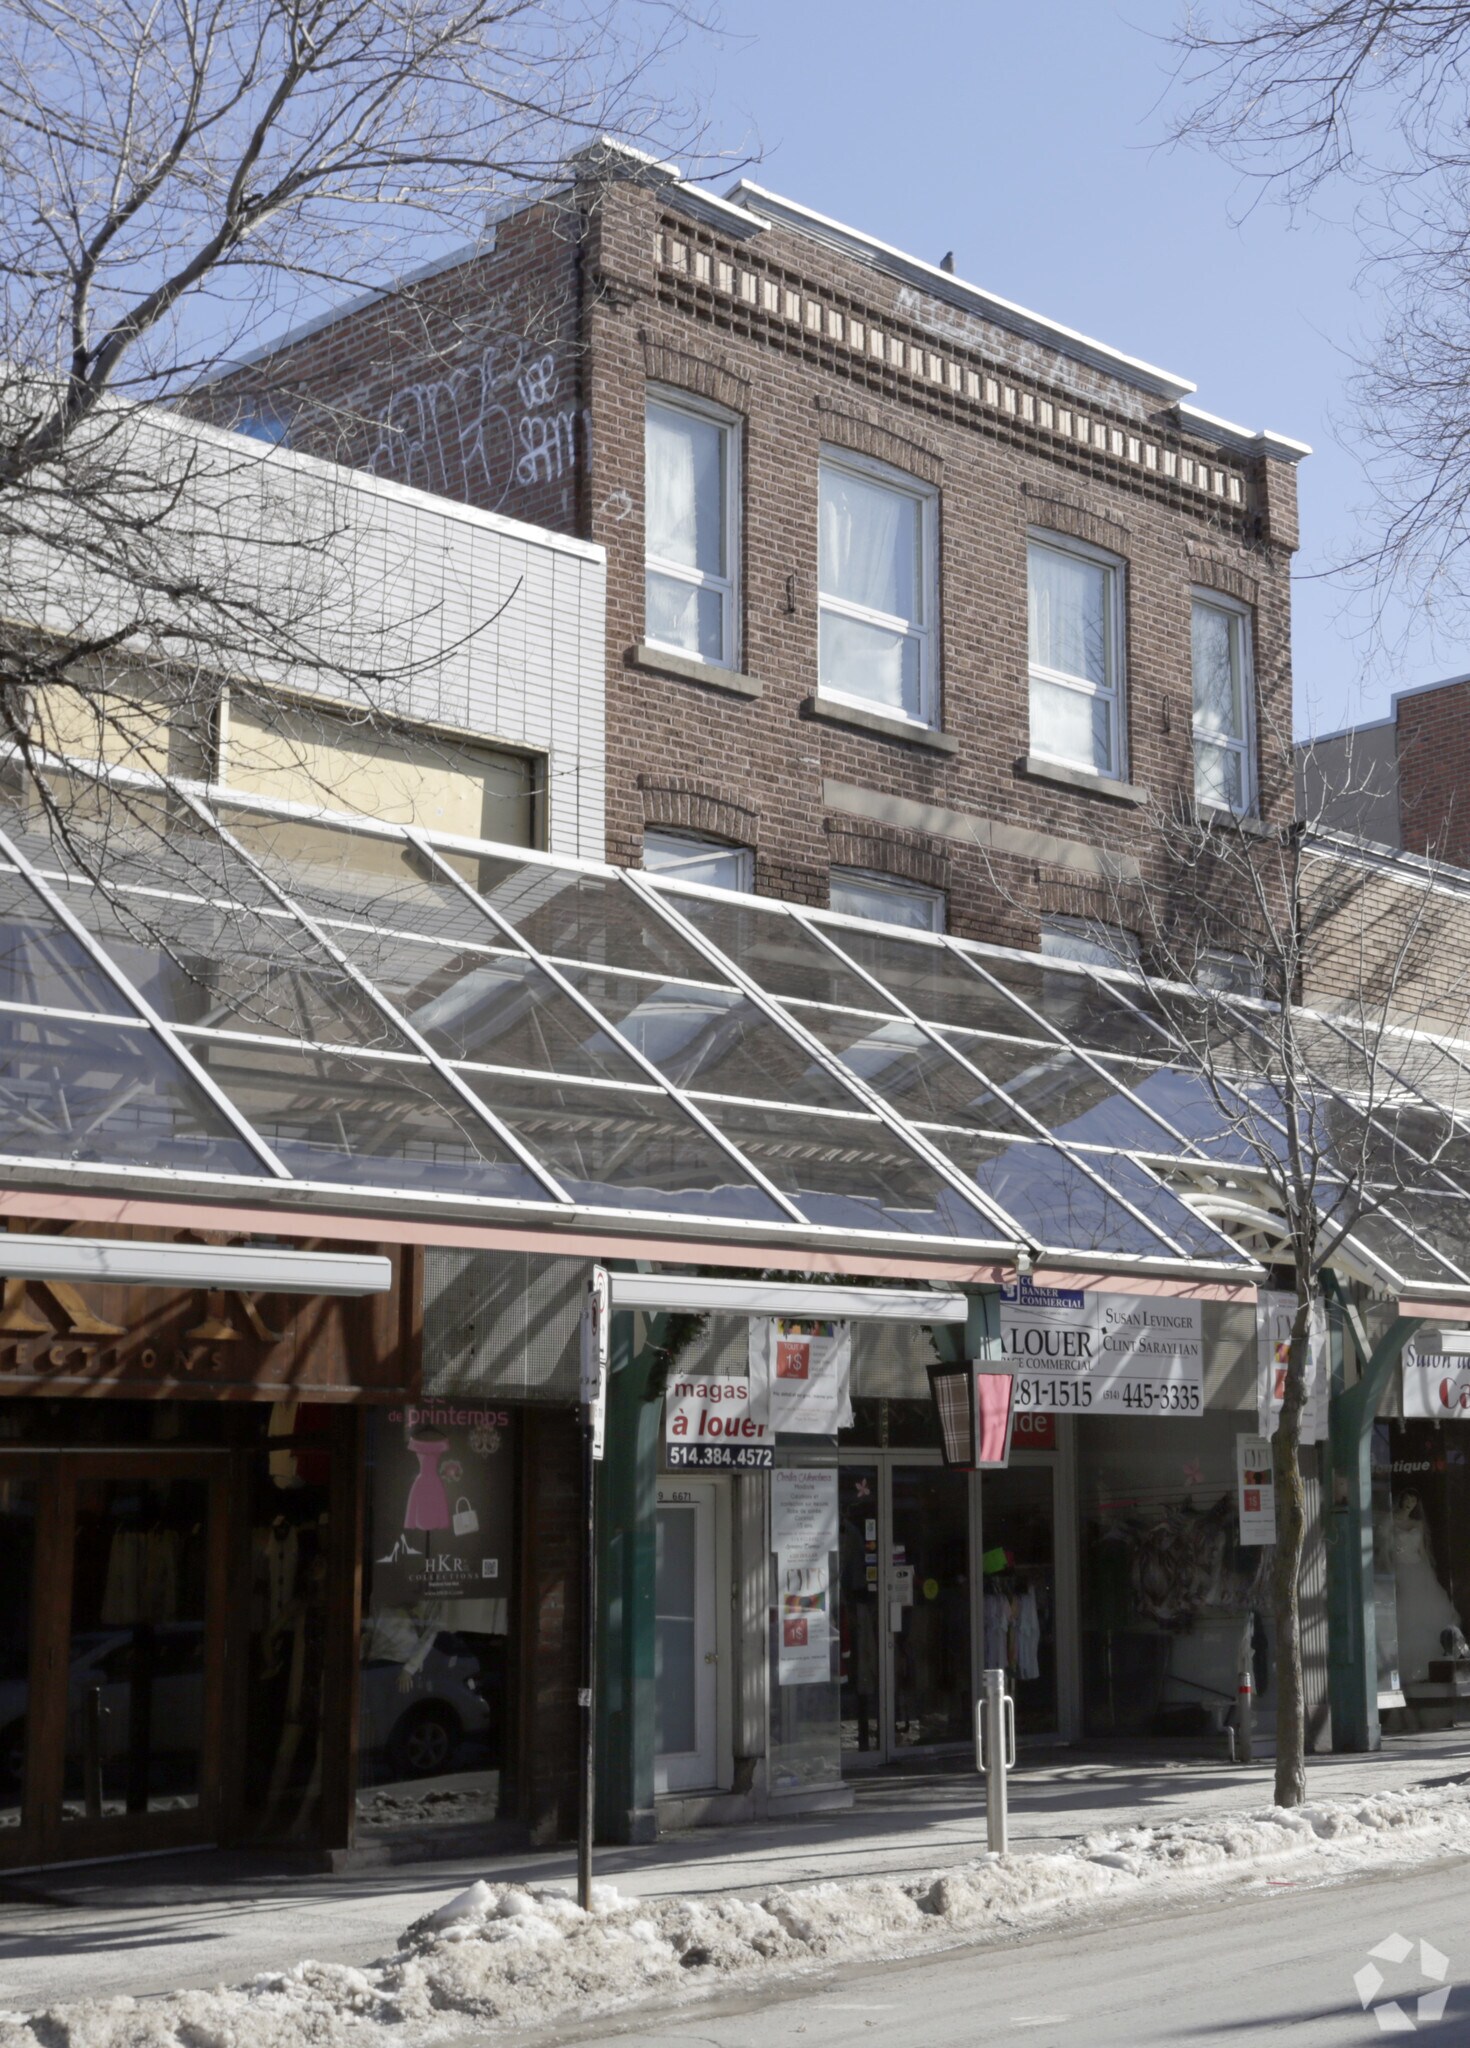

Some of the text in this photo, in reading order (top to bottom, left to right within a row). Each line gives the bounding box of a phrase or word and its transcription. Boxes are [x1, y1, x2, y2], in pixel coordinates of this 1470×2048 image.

[1021, 1287, 1059, 1298] BANKER
[1021, 1296, 1084, 1309] COMMERCIAL
[1105, 1308, 1141, 1326] SUSAN
[1142, 1311, 1193, 1329] LEVINGER
[1010, 1328, 1094, 1358] LOUER
[1102, 1335, 1199, 1356] CLINT SARAYLIAN
[1026, 1358, 1094, 1371] COMMERCIAL
[674, 1383, 748, 1403] magas
[1122, 1383, 1200, 1410] 445-3335
[388, 1406, 509, 1428] de printemps
[672, 1408, 689, 1436] à
[670, 1446, 773, 1467] 514.384.4572
[1372, 1459, 1431, 1474] outique
[425, 1554, 464, 1573] HKR
